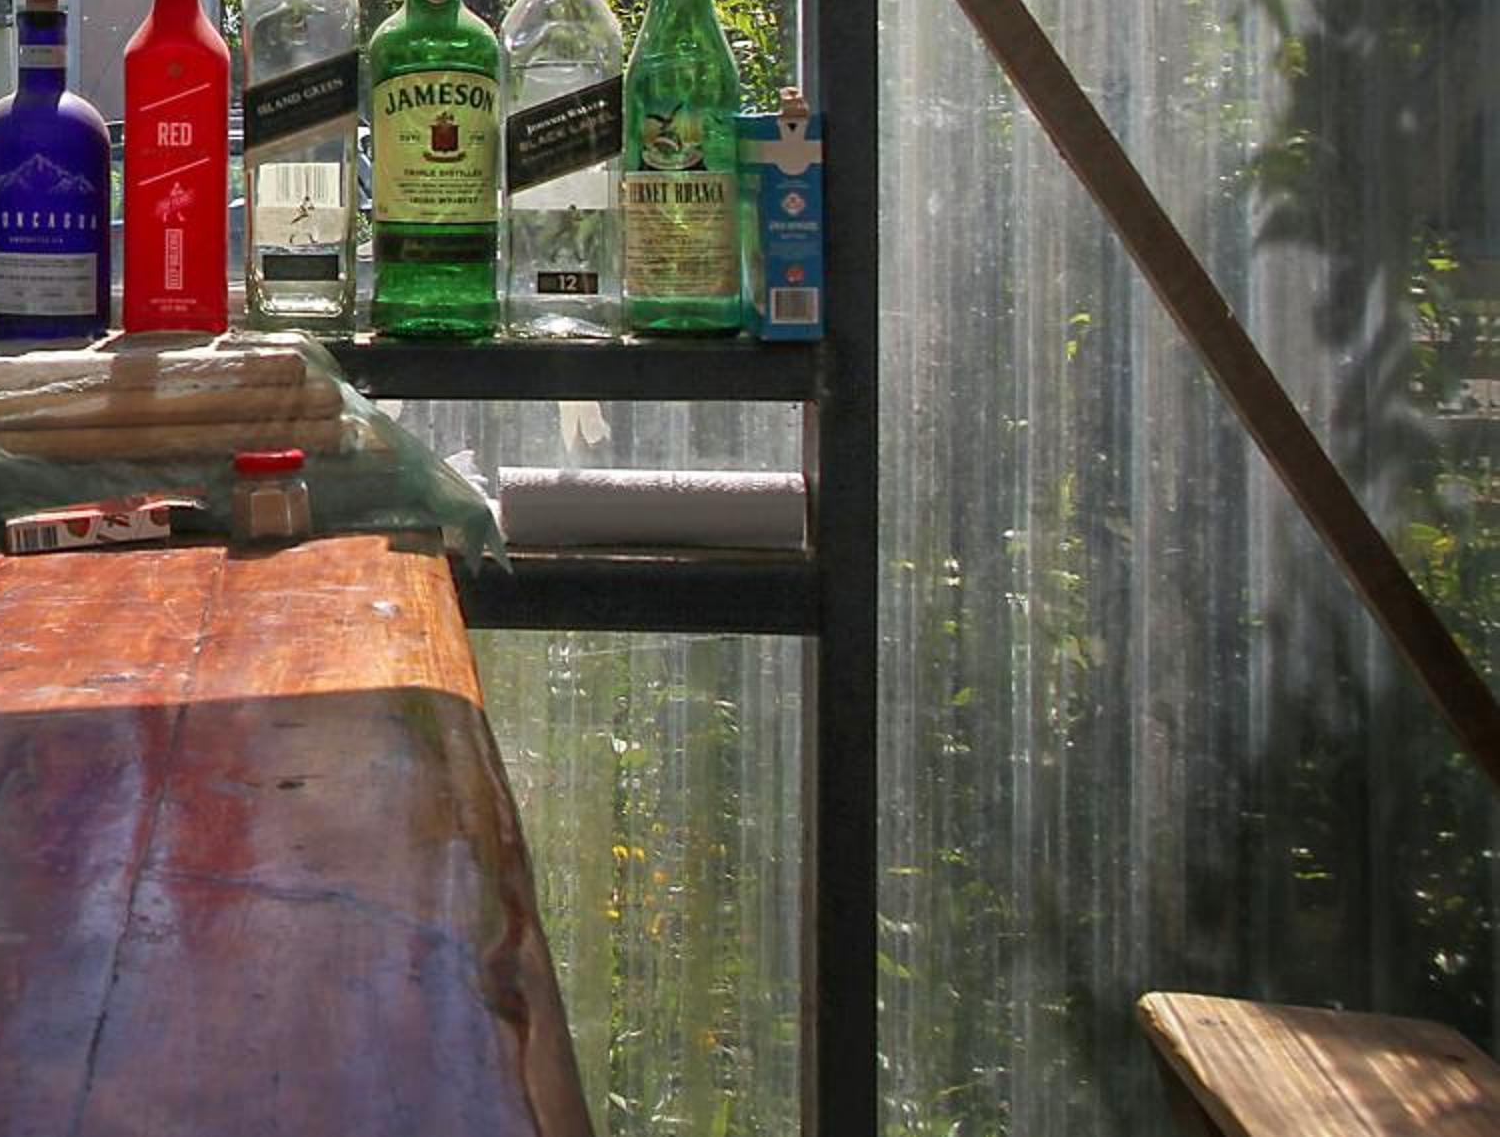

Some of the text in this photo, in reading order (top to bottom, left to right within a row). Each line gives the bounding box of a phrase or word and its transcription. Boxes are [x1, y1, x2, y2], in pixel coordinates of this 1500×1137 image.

[385, 82, 495, 116] JAMESON
[157, 122, 193, 147] RED
[558, 274, 578, 291] 12
